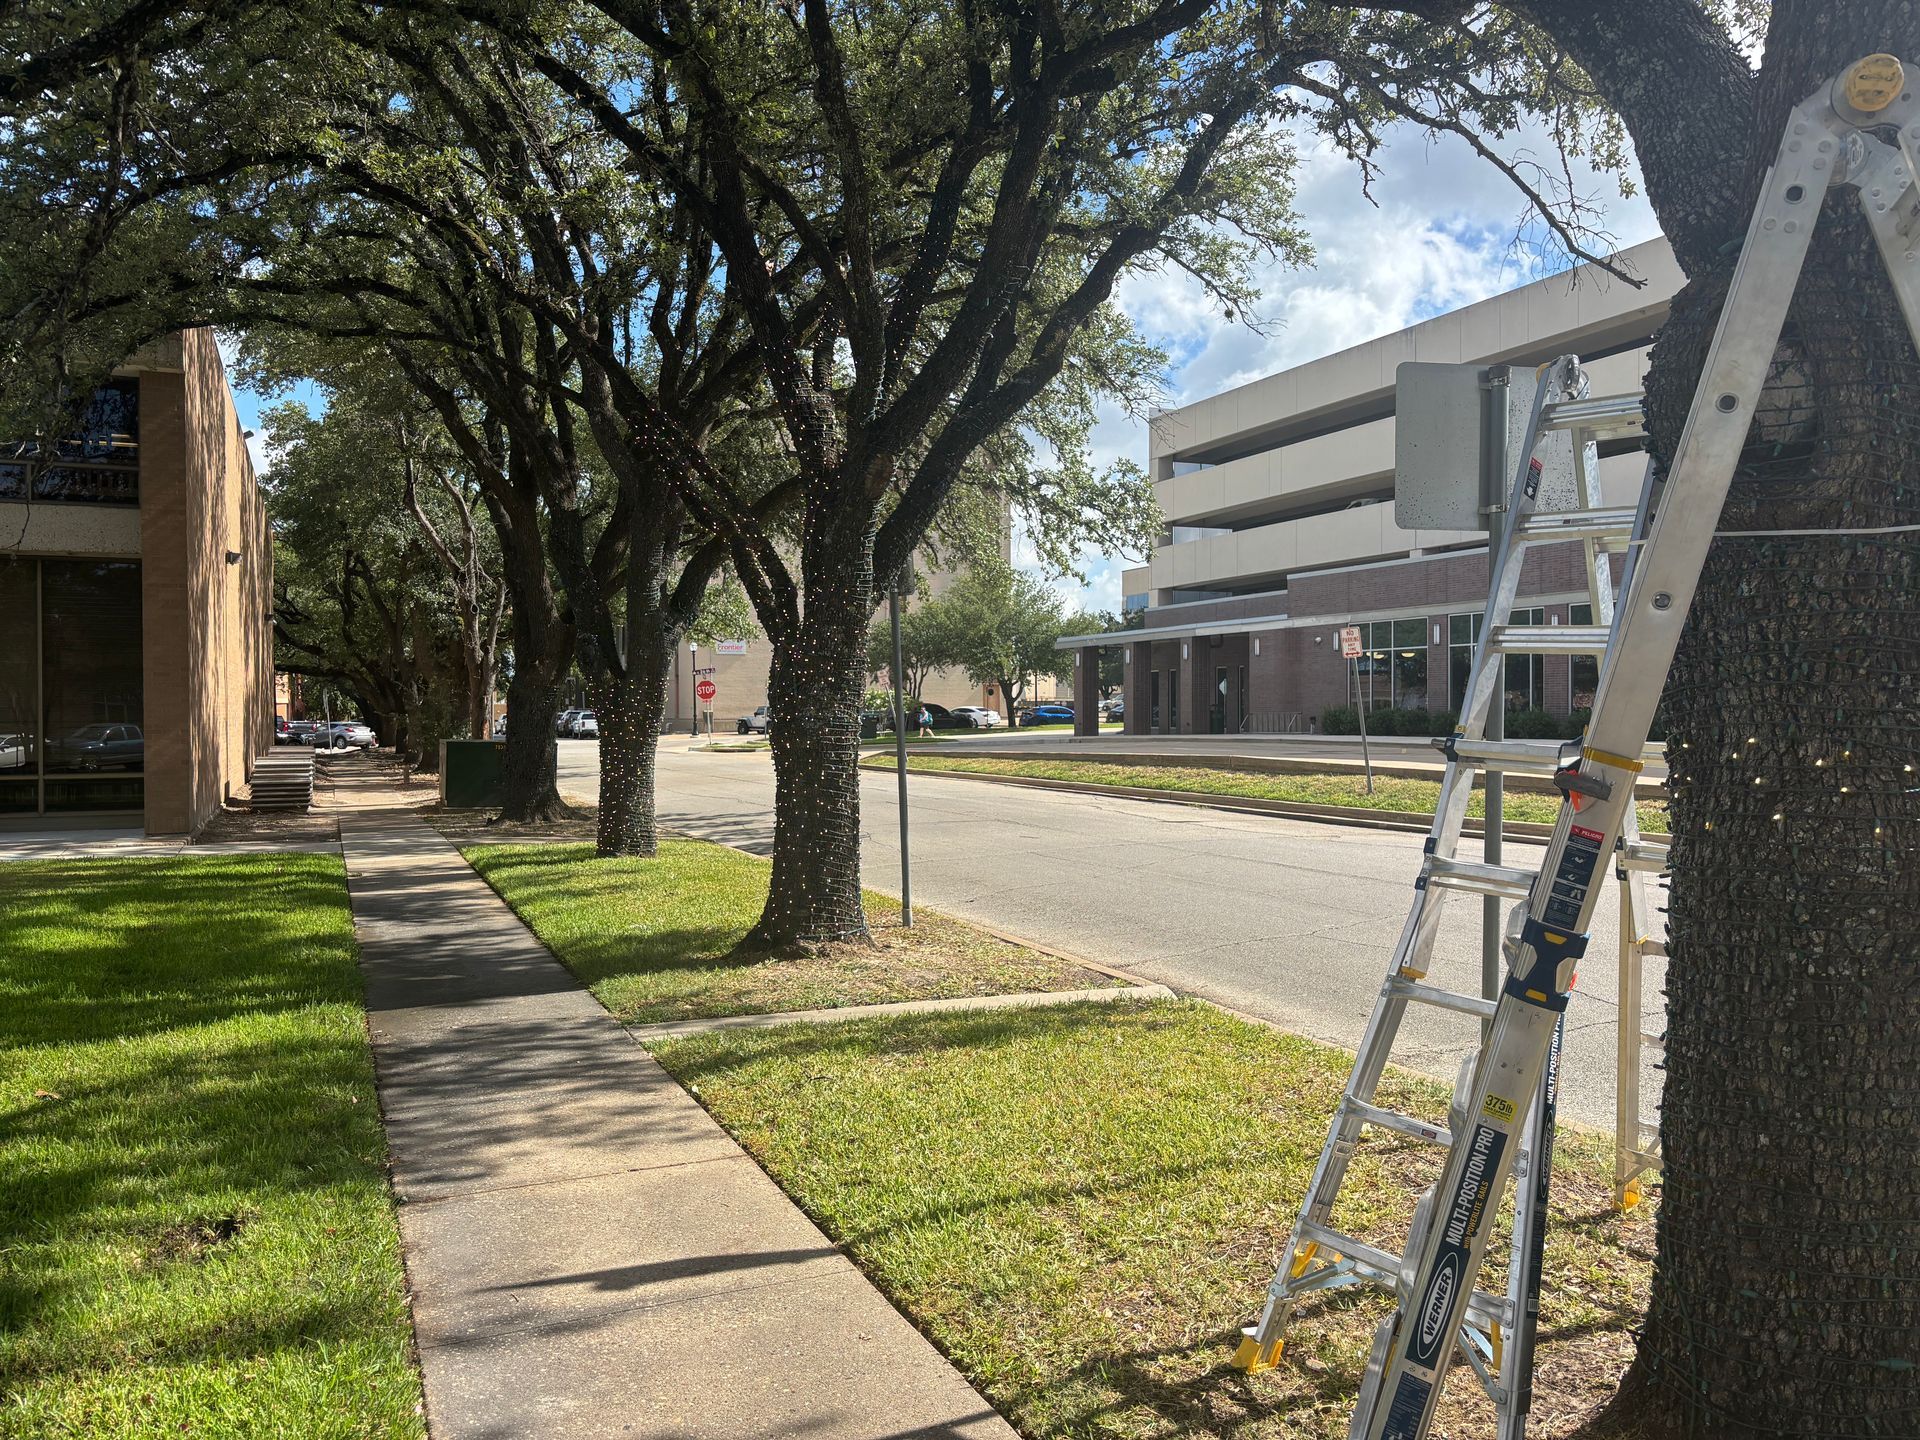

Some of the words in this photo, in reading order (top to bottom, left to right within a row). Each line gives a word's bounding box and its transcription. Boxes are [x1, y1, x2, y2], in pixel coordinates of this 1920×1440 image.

[697, 685, 715, 695] STOP
[1581, 830, 1602, 840] PELIGRO
[1543, 1127, 1551, 1179] WERNER
[1446, 1152, 1487, 1246] MULTI-POSITION
[1475, 1127, 1495, 1154] PRO
[1466, 1200, 1482, 1237] POWERLITE
[1478, 1180, 1489, 1200] RAILS
[1424, 1272, 1452, 1337] WERNER
